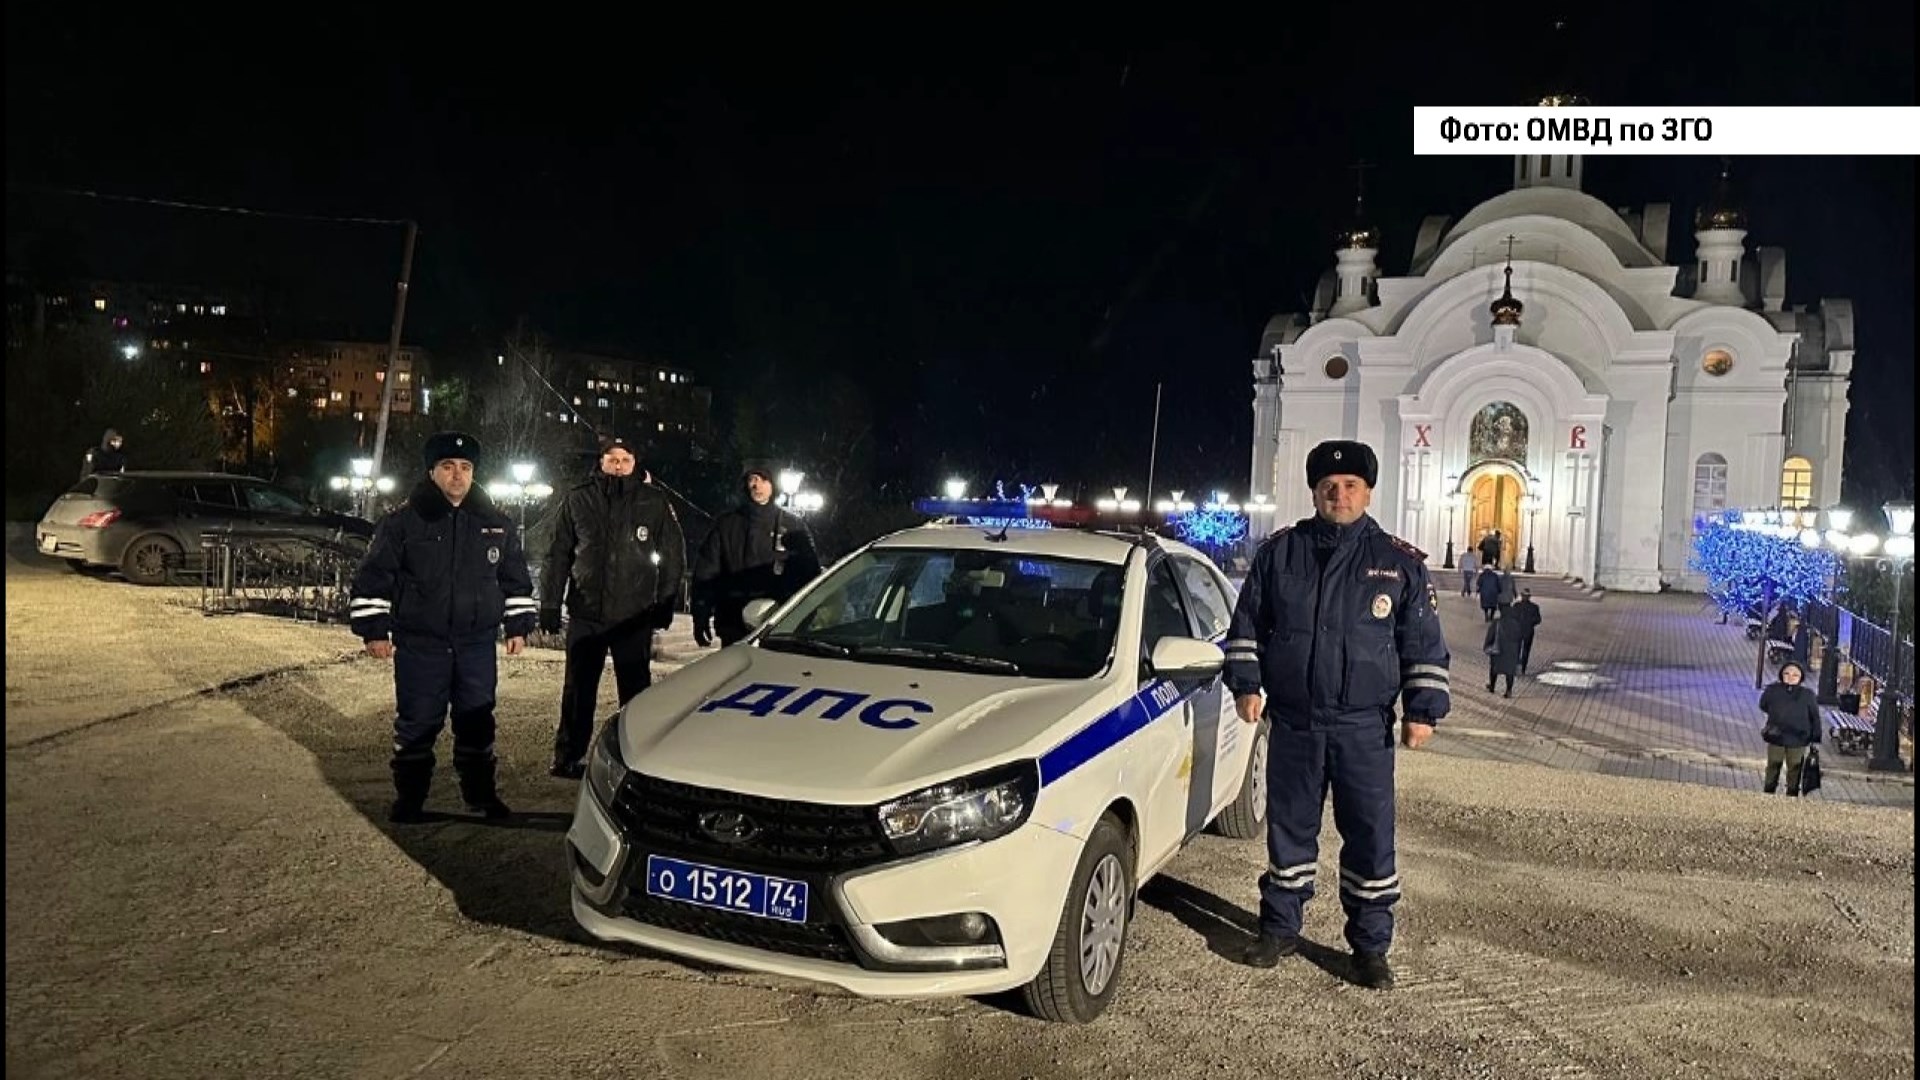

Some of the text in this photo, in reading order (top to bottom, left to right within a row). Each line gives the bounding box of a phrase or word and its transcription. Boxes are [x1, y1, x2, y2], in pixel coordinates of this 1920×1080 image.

[697, 682, 934, 729] ДПС
[686, 868, 752, 908] 1512
[769, 882, 797, 908] 74
[771, 905, 792, 917] RUS
